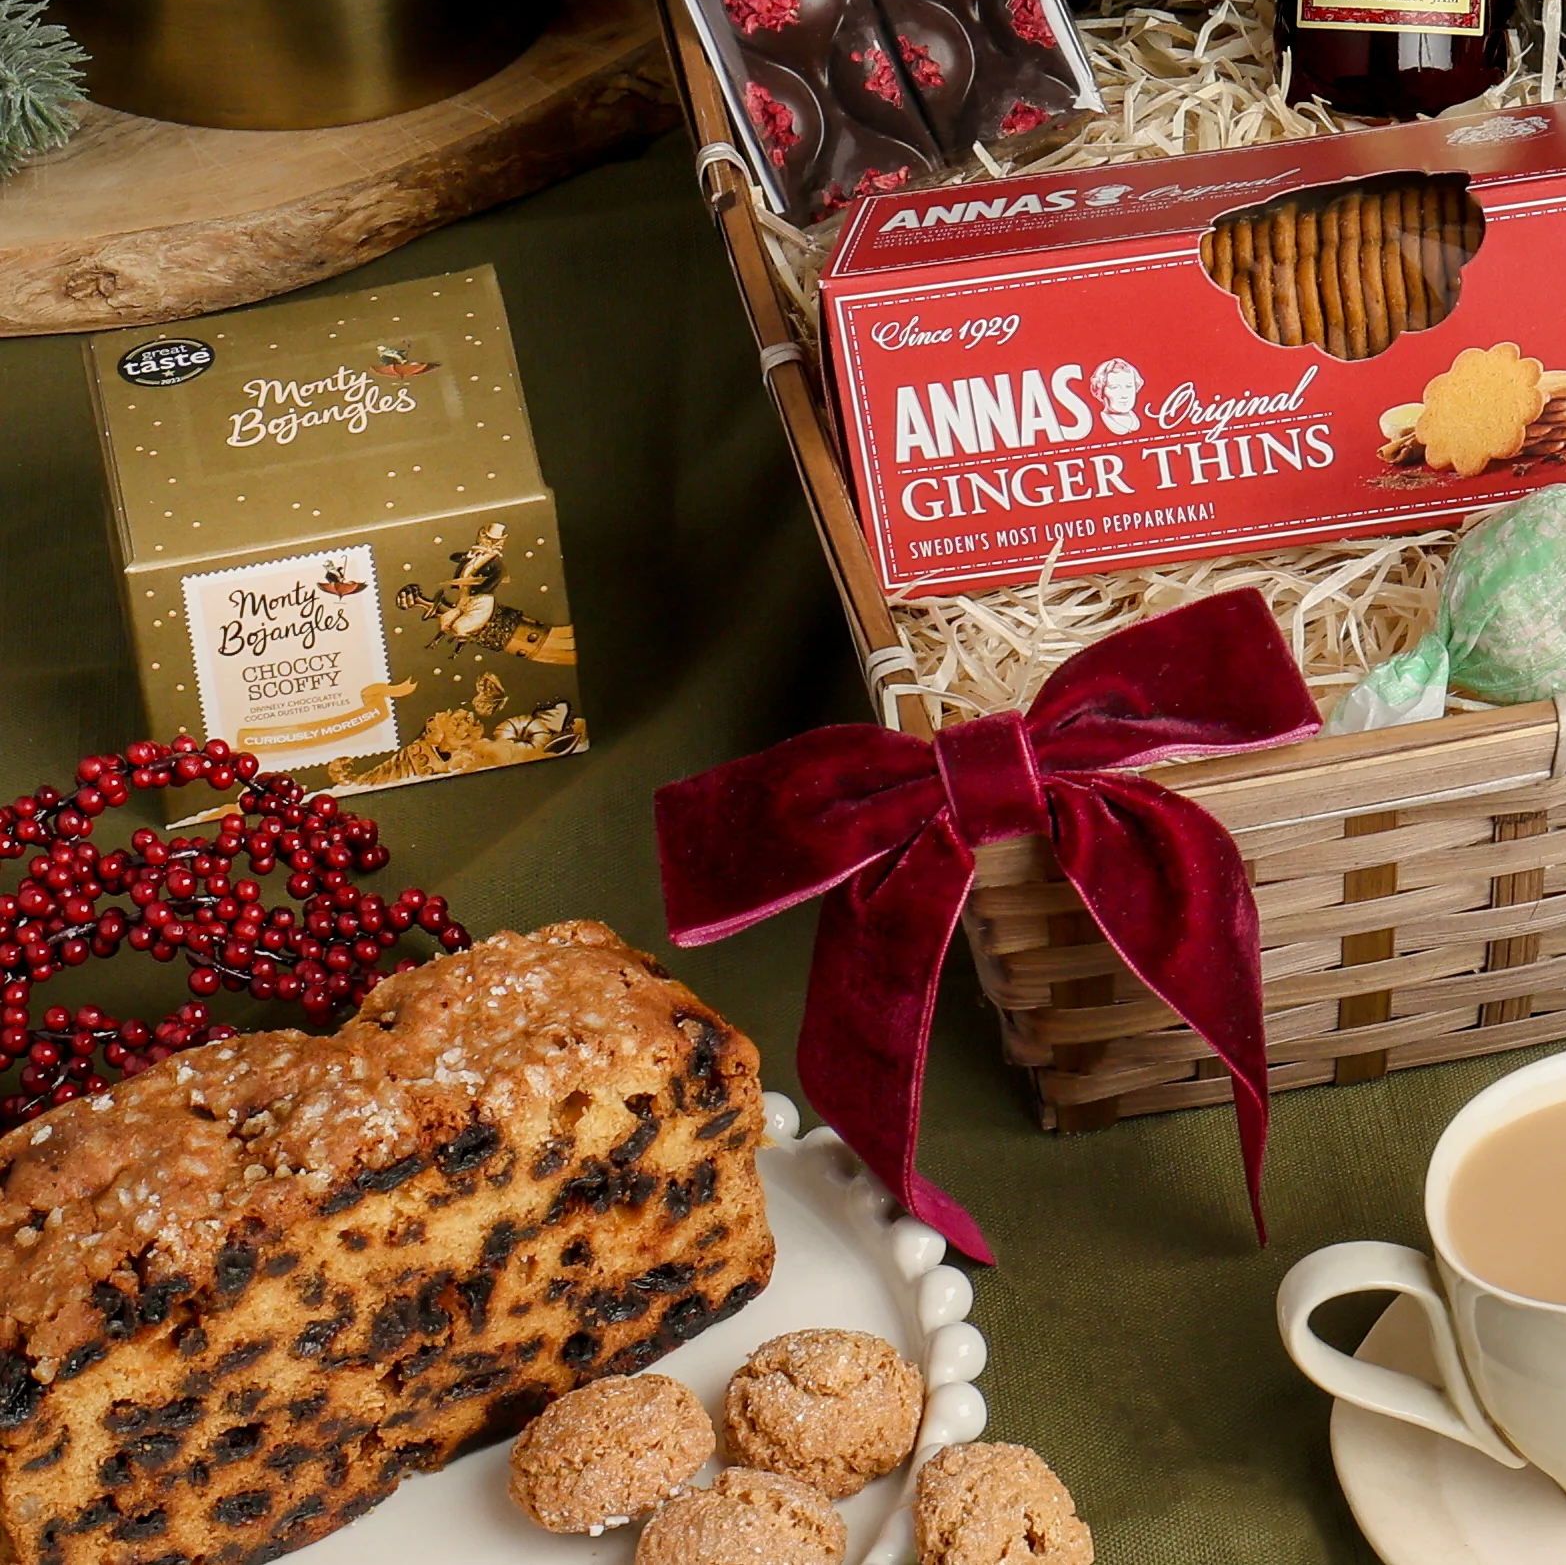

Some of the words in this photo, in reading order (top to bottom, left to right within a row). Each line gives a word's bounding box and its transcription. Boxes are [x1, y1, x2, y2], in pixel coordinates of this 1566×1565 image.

[878, 188, 1078, 232] ANNAS
[871, 316, 954, 350] Since
[957, 314, 1021, 350] 1929
[123, 351, 211, 376] taste
[142, 344, 188, 361] great
[243, 366, 374, 408] Monty
[226, 385, 417, 448] Bojangles
[896, 364, 1093, 464] ANNAS
[1144, 364, 1319, 443] Original
[901, 453, 1135, 522] GINGER
[1141, 422, 1336, 491] THINS
[909, 532, 990, 559] SWEDEN'S
[996, 526, 1038, 549] MOST
[1044, 520, 1096, 543] LOVED
[1102, 502, 1216, 534] PEPPARKAKA!
[229, 580, 320, 620] Monty
[218, 604, 350, 657] Bojangles
[242, 651, 342, 683] CHOCCY
[248, 670, 342, 701] SCOFFY
[244, 712, 276, 723] COCOA
[278, 706, 310, 718] DUSTED
[312, 698, 351, 712] TRUFFLES
[250, 701, 286, 714] DIVINELY
[288, 692, 343, 708] CHOCOLATEY
[244, 729, 322, 746] CURIOUSLY
[320, 708, 381, 737] MOREISH
